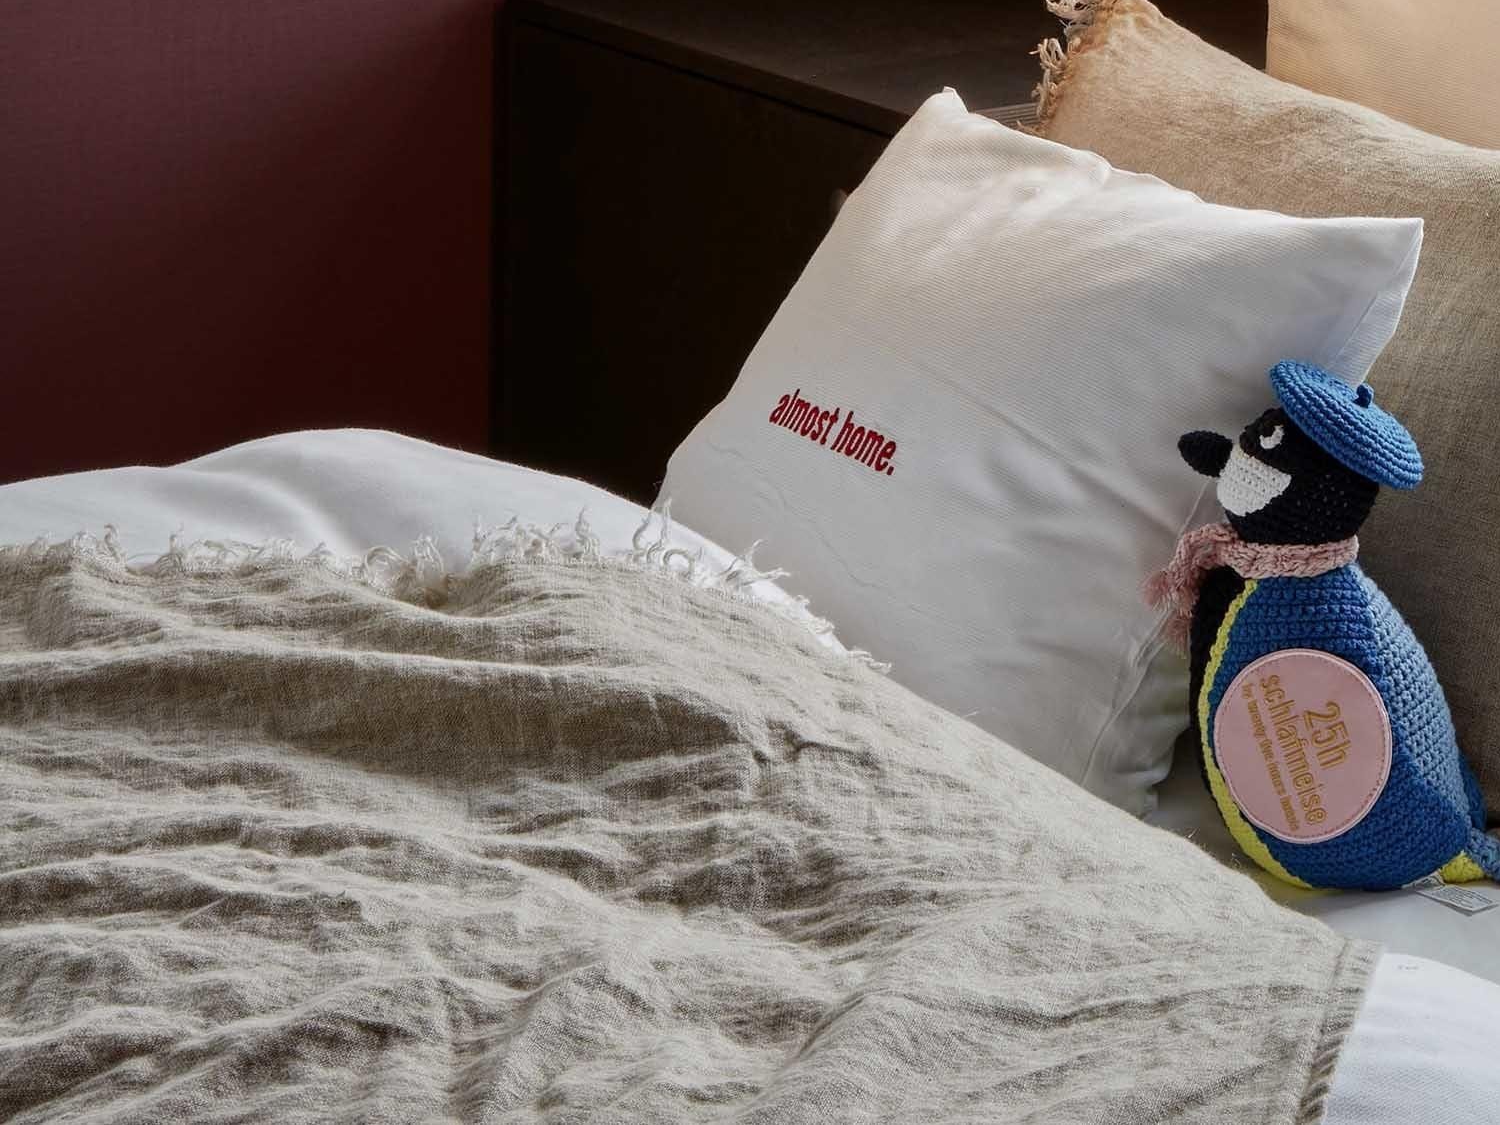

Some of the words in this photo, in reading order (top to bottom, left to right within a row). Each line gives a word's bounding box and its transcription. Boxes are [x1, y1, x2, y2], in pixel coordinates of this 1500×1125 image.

[769, 388, 840, 445] almost
[830, 411, 897, 476] home.
[1260, 674, 1329, 825] schlafmeise
[1302, 701, 1351, 770] 25h
